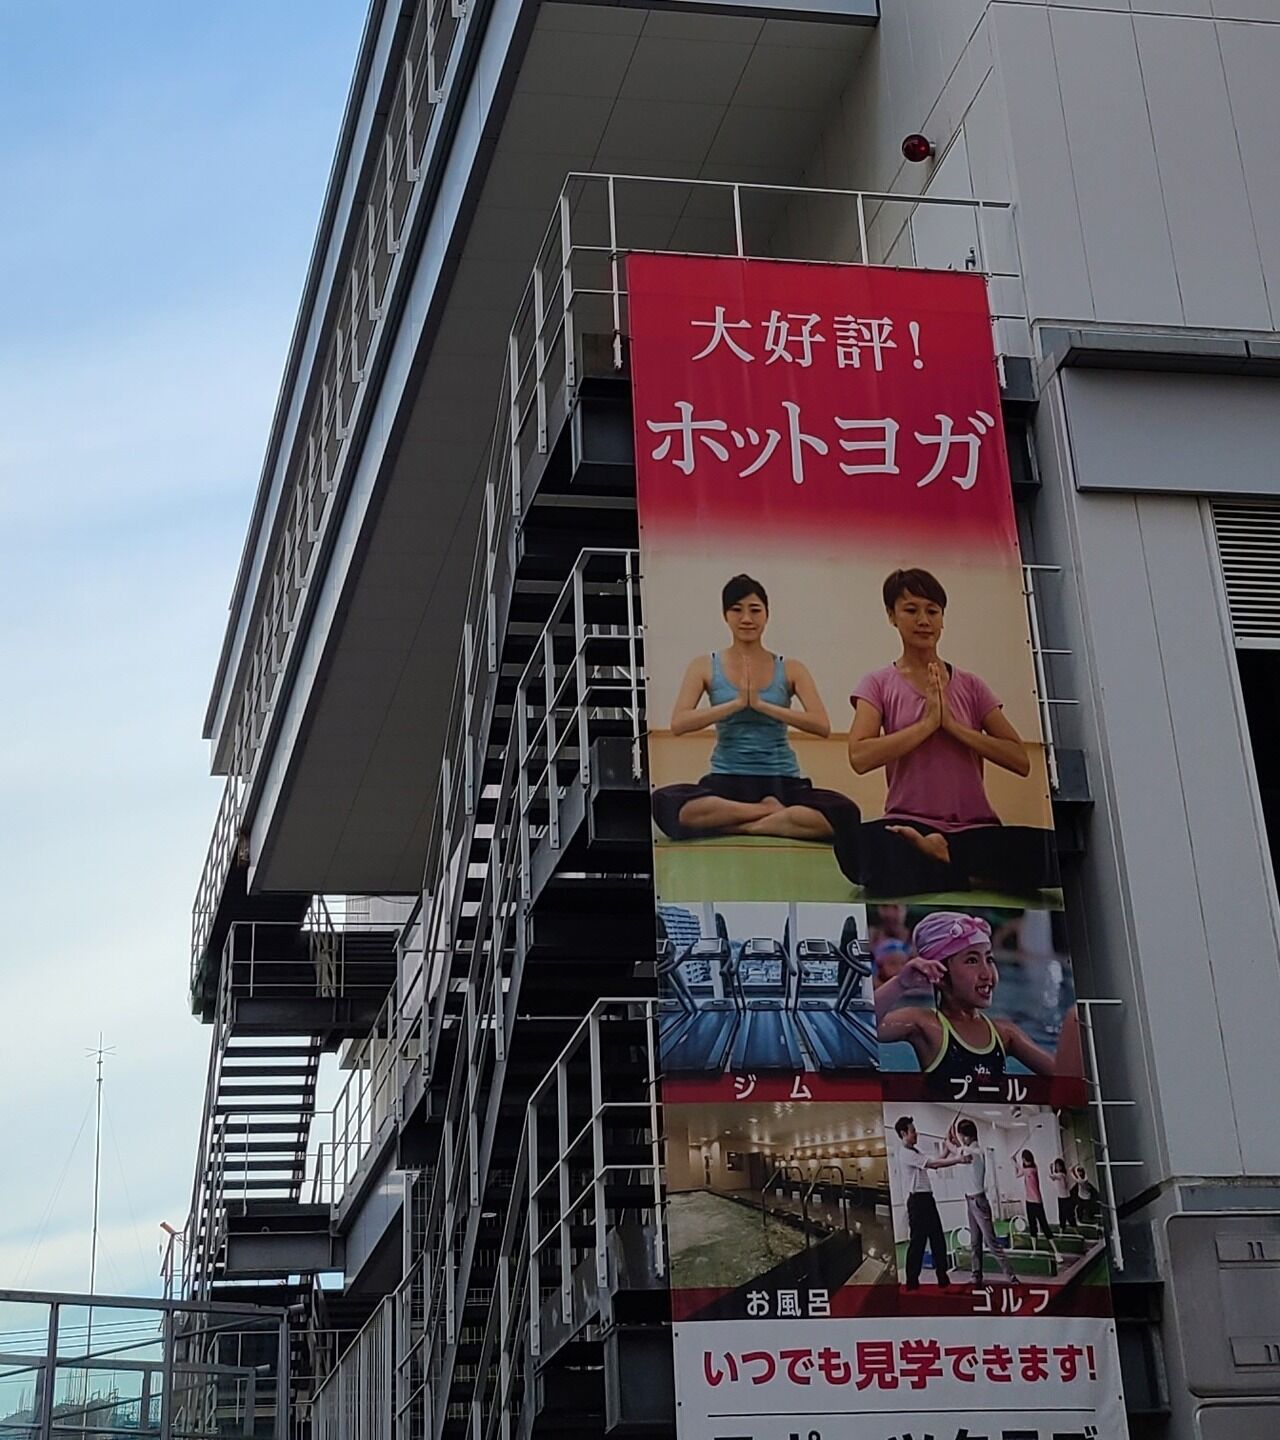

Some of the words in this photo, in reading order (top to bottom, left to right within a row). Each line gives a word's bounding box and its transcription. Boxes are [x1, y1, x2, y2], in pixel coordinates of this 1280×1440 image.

[691, 306, 924, 371] 大好評!
[646, 400, 996, 491] ホットヨガ
[949, 1076, 1028, 1103] プール
[745, 1289, 831, 1317] お風呂
[972, 1288, 1051, 1314] ゴルフ
[703, 1339, 1097, 1391] いつでも見学できます!
